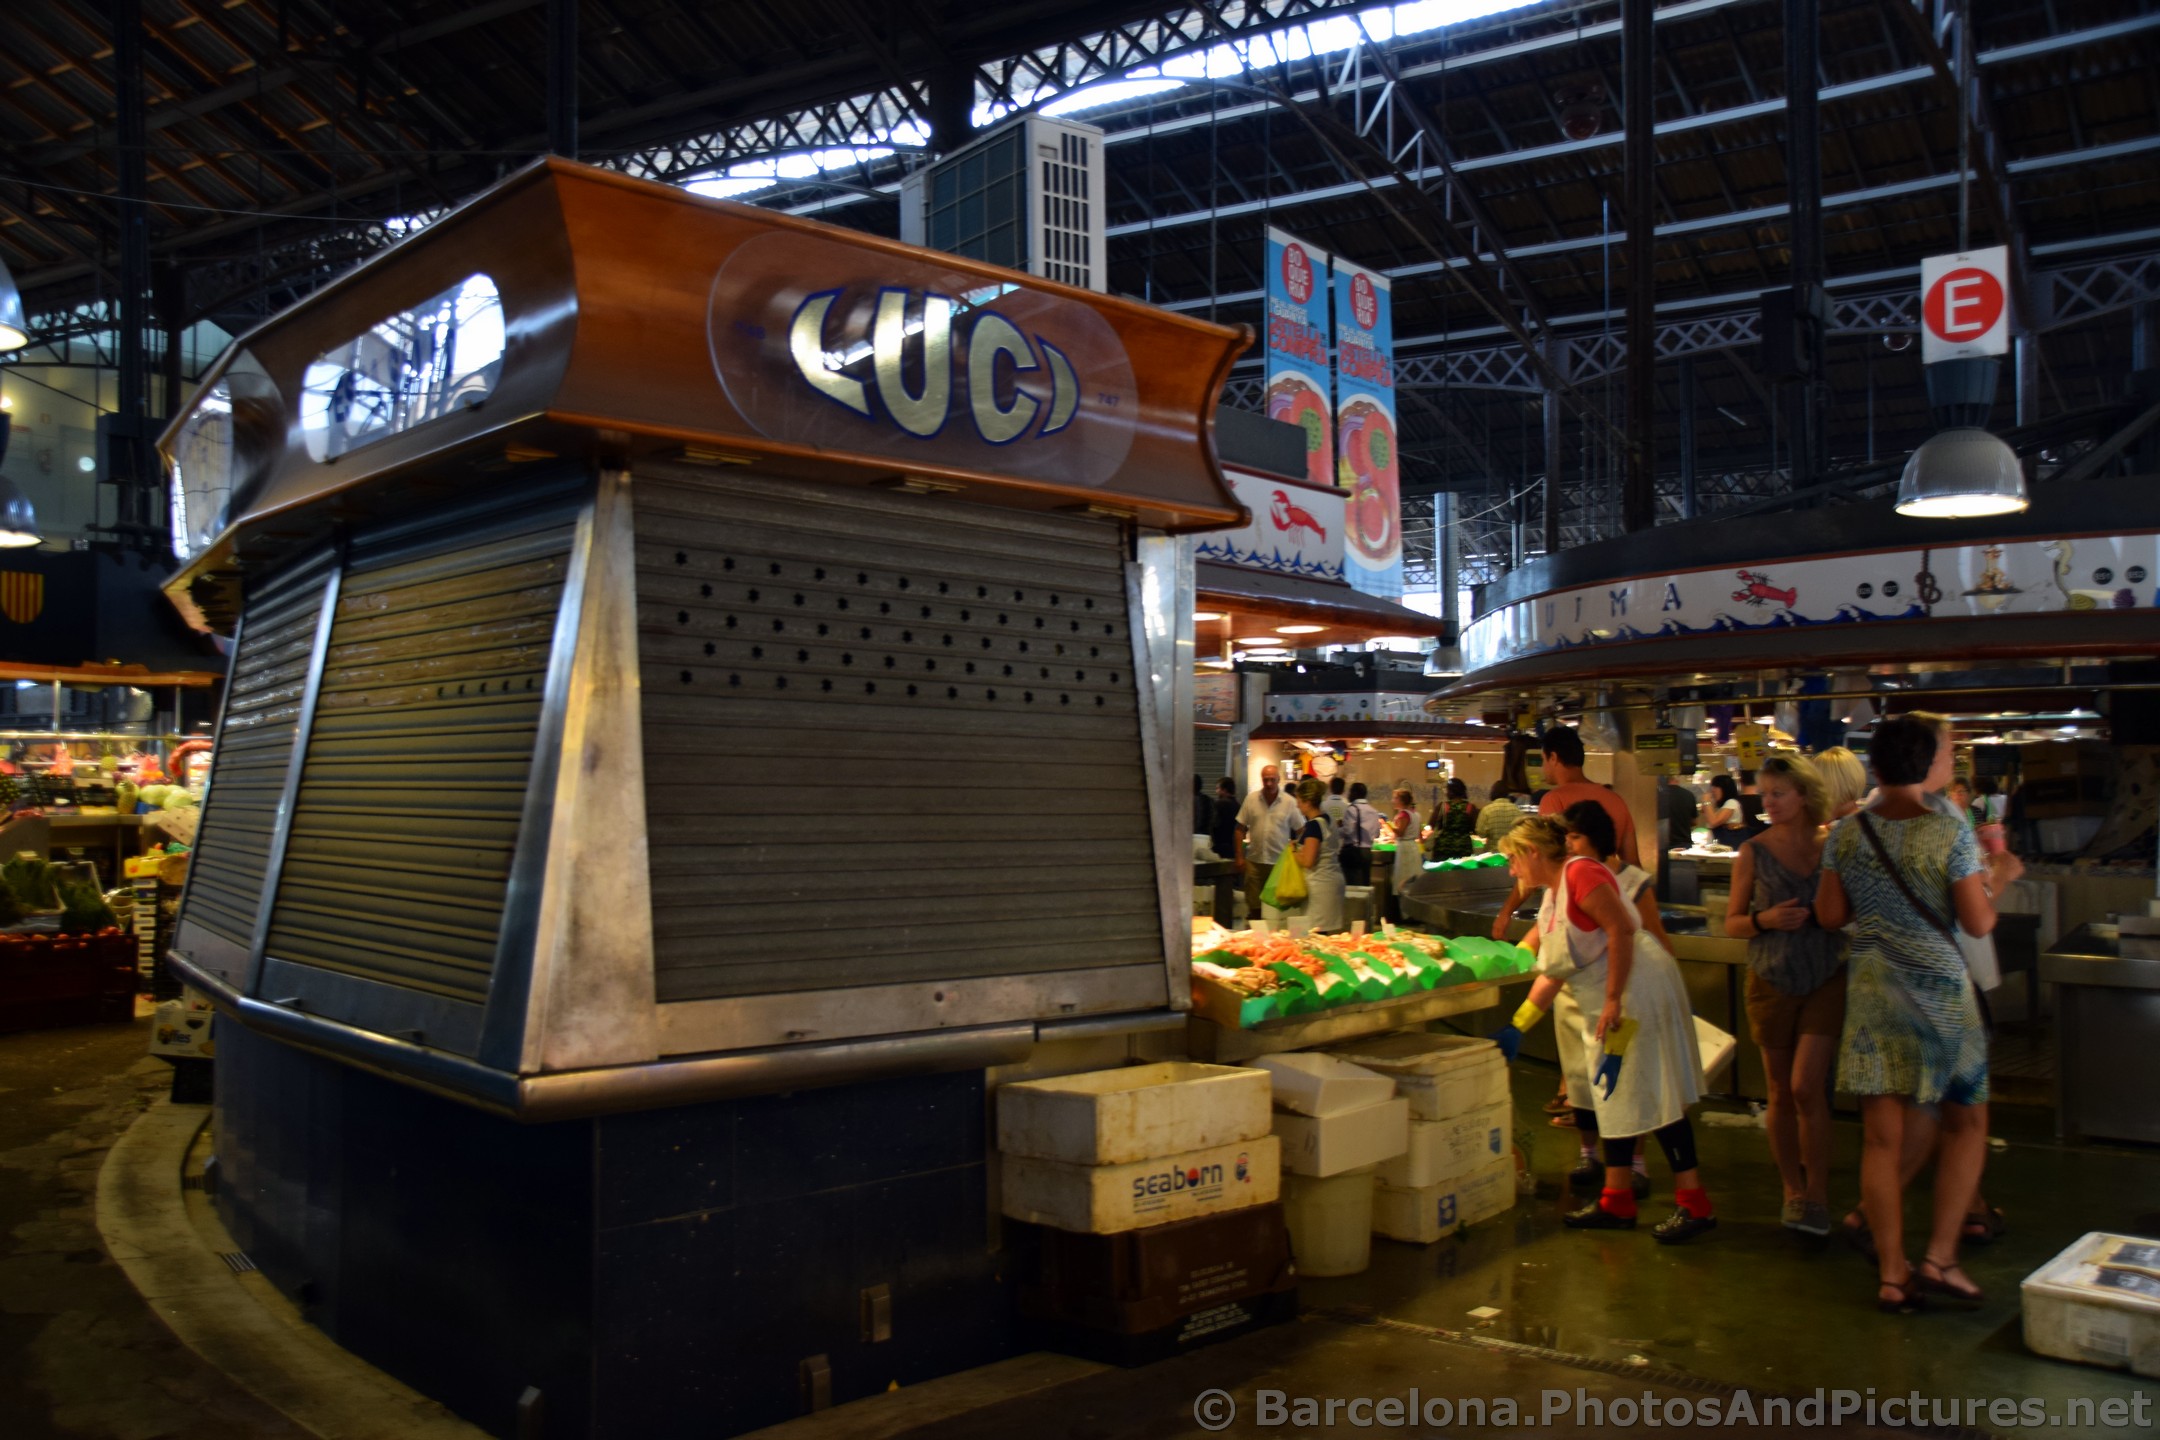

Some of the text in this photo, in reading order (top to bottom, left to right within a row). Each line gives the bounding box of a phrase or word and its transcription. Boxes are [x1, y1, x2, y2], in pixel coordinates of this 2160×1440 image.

[1943, 276, 1983, 334] E
[787, 285, 1082, 447] LUCI
[1132, 1163, 1224, 1198] seaborn
